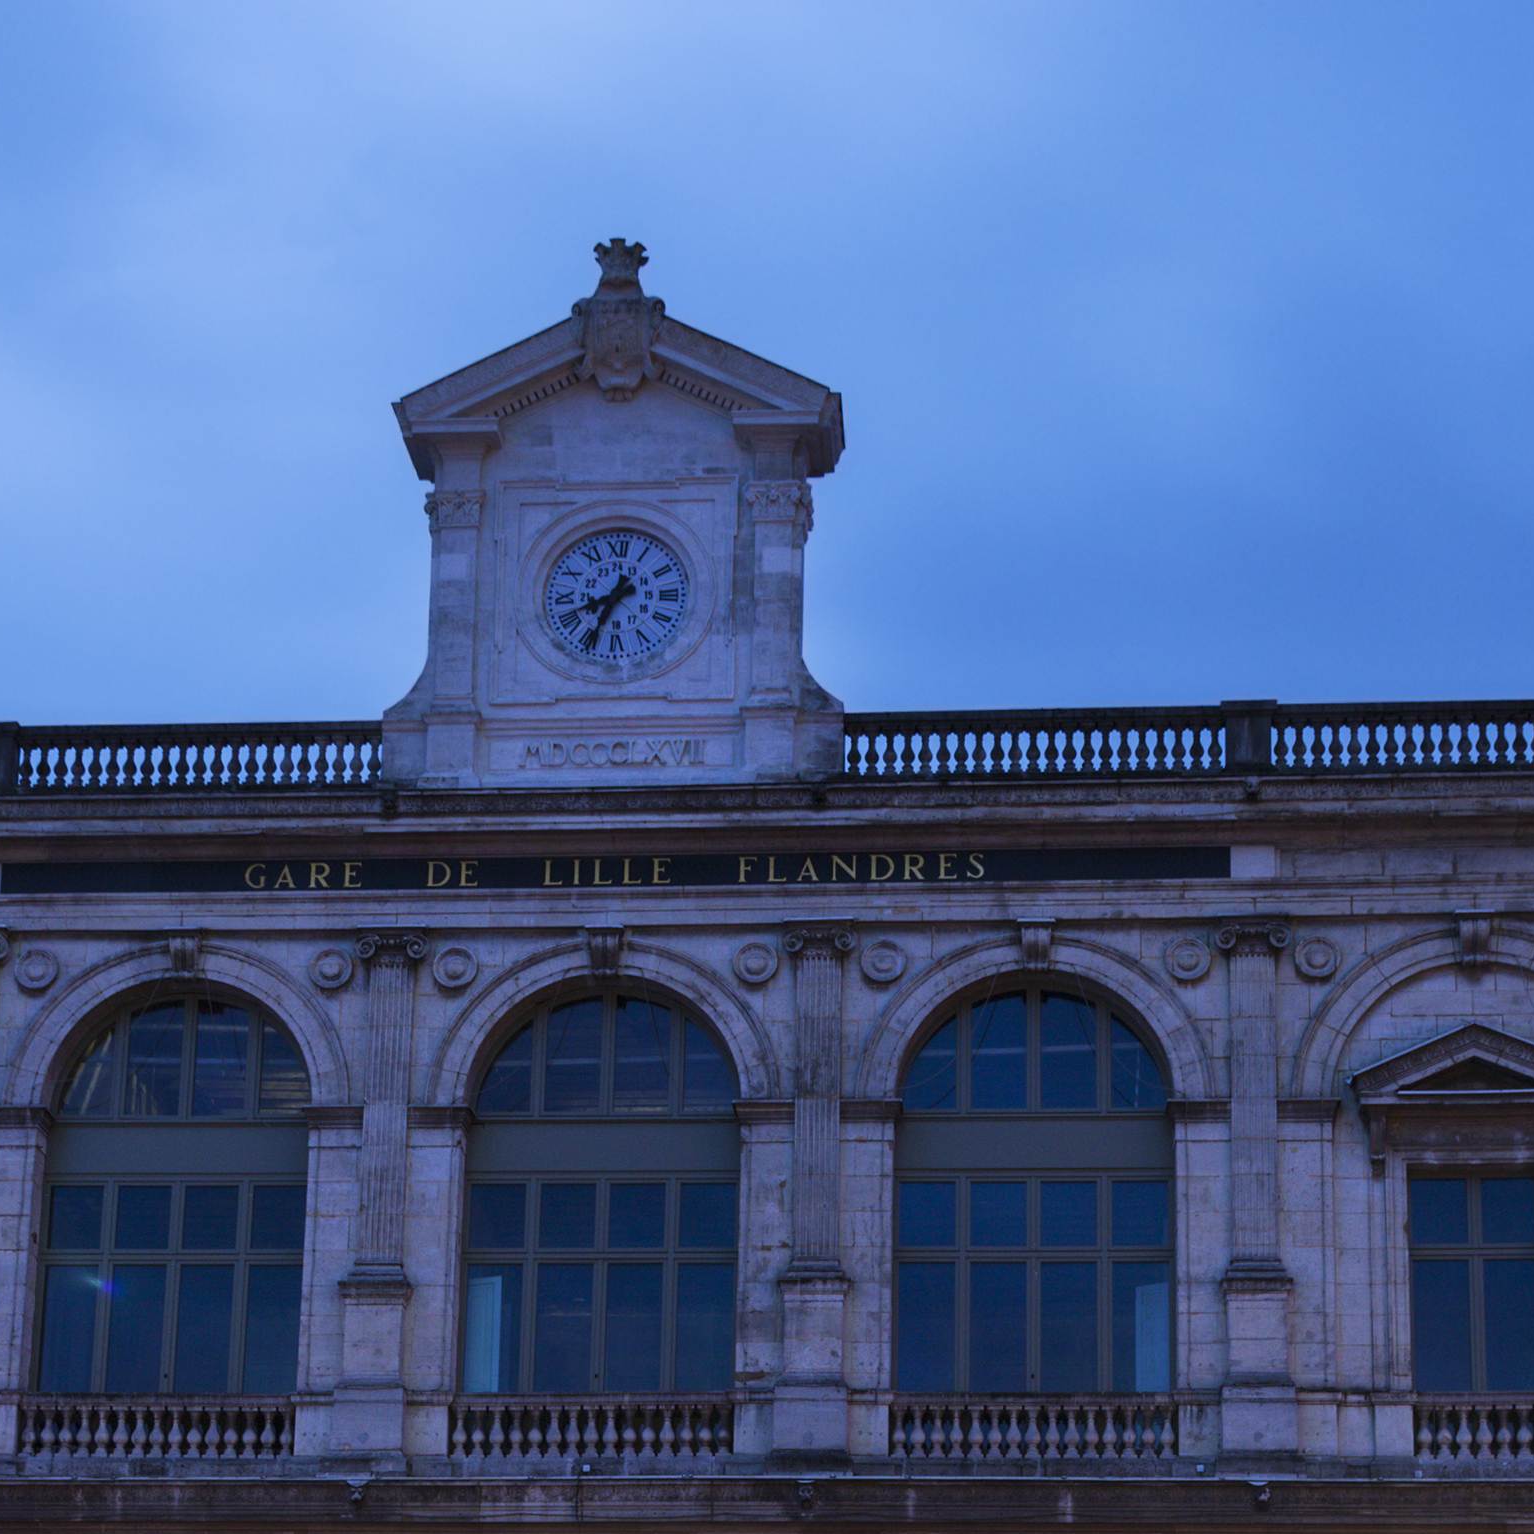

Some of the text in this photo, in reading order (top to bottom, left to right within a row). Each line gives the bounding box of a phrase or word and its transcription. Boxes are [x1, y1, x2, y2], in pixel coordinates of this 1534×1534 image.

[581, 545, 602, 567] XI
[608, 541, 629, 558] XII
[561, 565, 583, 582] X
[612, 563, 623, 572] 24
[652, 564, 672, 578] II
[585, 579, 596, 588] 22
[659, 588, 678, 602] III
[518, 740, 706, 768] MDCCCLXVII
[245, 853, 986, 889] GARE DE LILLE FLANDRES
